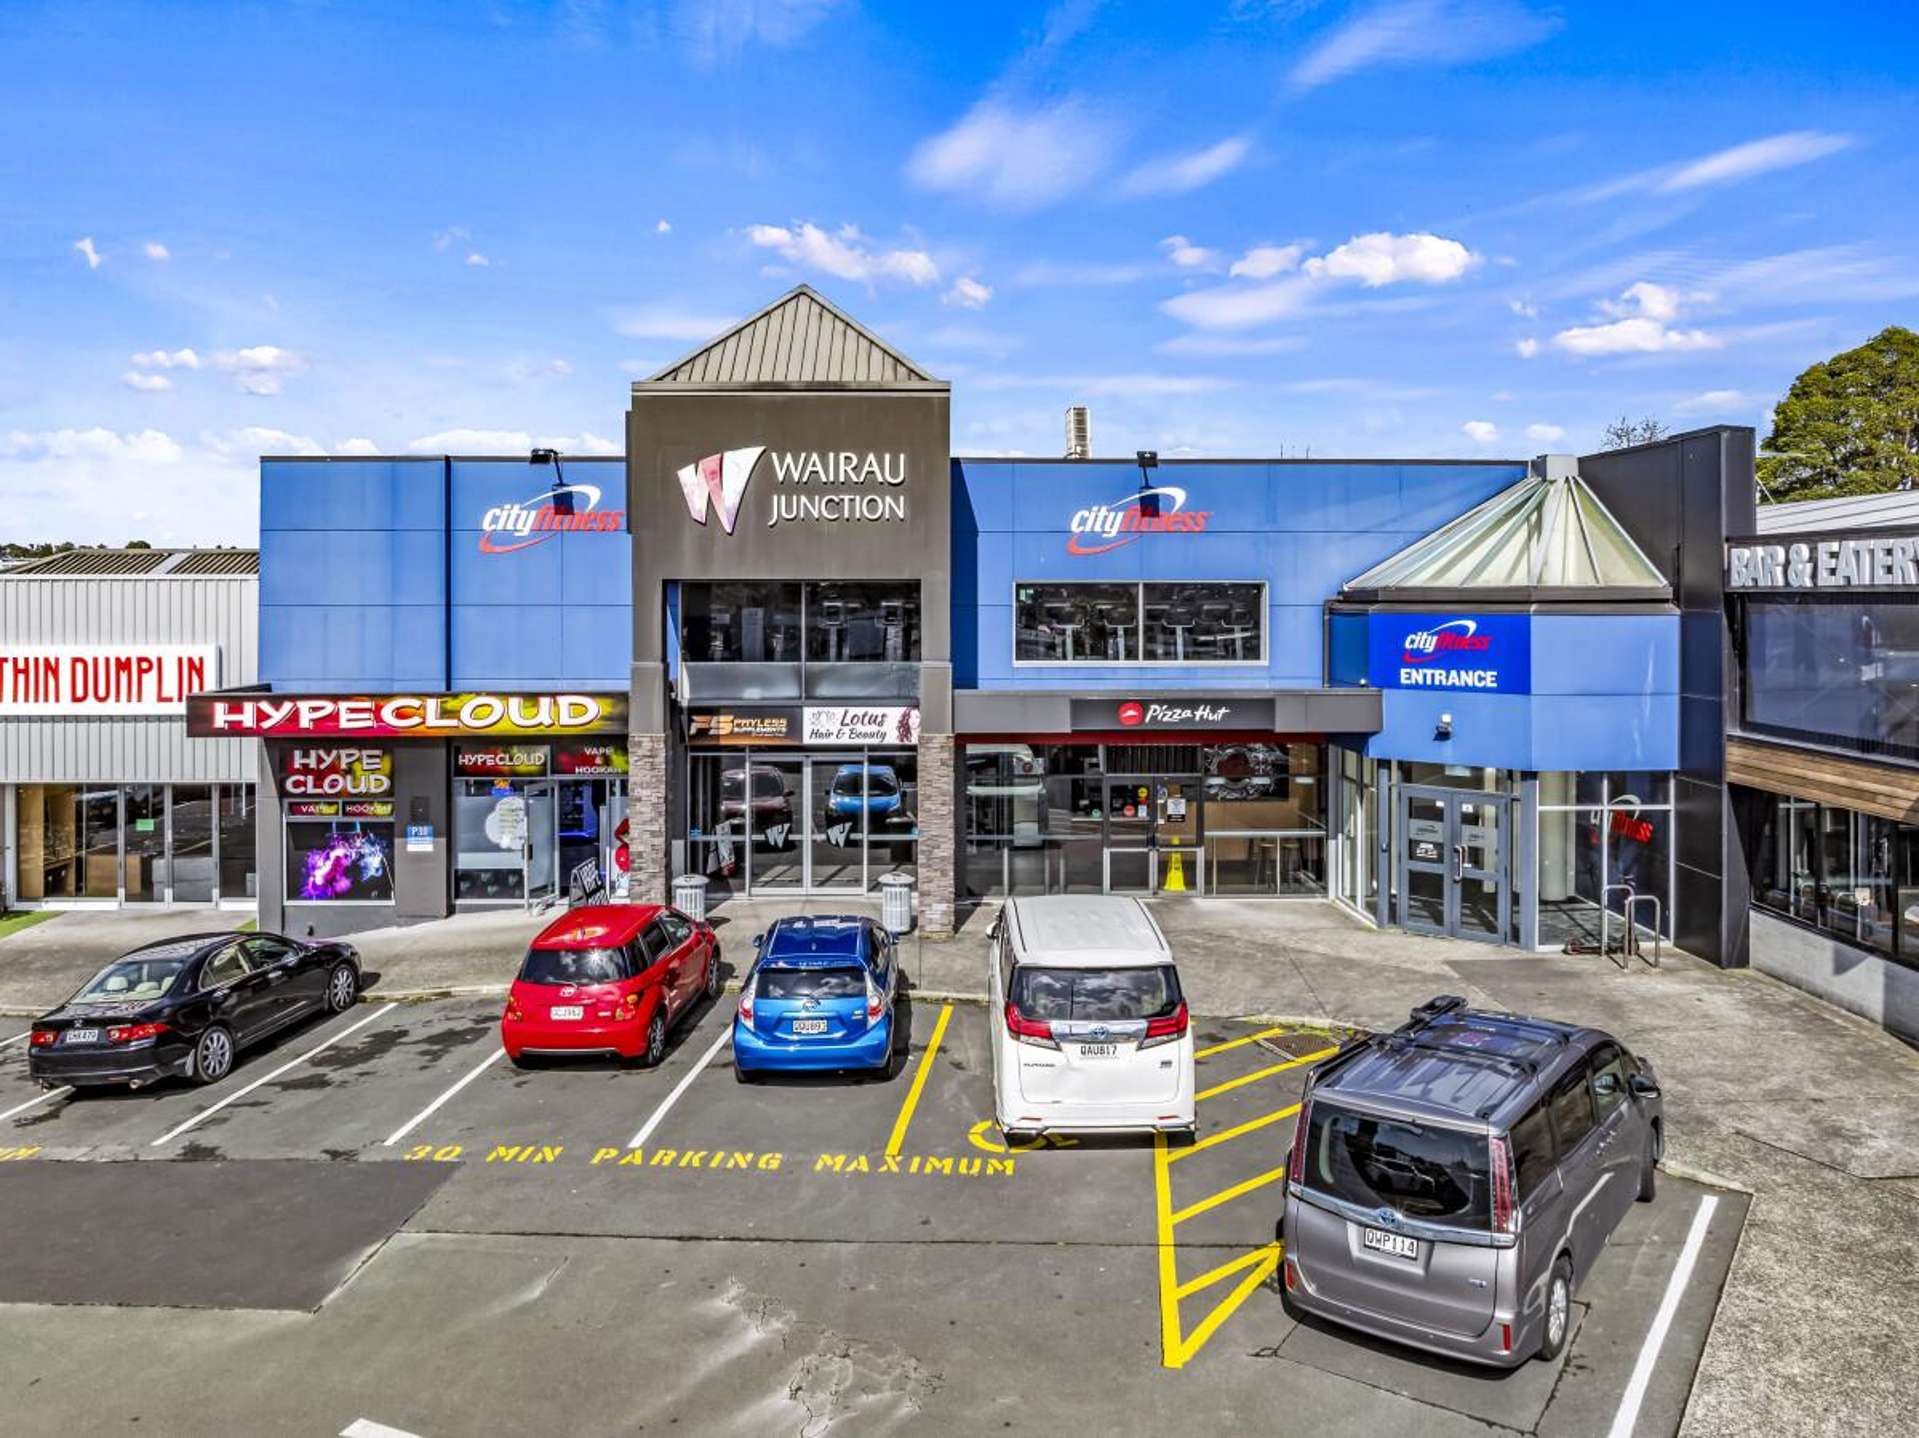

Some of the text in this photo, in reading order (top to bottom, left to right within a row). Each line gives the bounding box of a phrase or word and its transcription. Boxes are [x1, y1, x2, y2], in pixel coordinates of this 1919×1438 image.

[771, 452, 905, 484] WAIRAU
[767, 494, 905, 526] JUNCTION
[1731, 545, 1785, 587] BAR
[1788, 543, 1814, 588] &
[70, 656, 204, 703] DUMPLIN
[1400, 668, 1498, 688] ENTRANCE
[212, 693, 602, 730] HYPECLOUD
[839, 708, 888, 728] Lotus
[1144, 704, 1232, 724] Pizza Hut
[808, 727, 888, 743] Hair & Beauty
[293, 749, 384, 770] HYPE
[458, 752, 546, 766] HYPECLOUD
[285, 773, 392, 794] CLOUD
[403, 1146, 1016, 1176] 30 MIN PARKING MAXIMUM
[1366, 1229, 1416, 1257] QWP114
